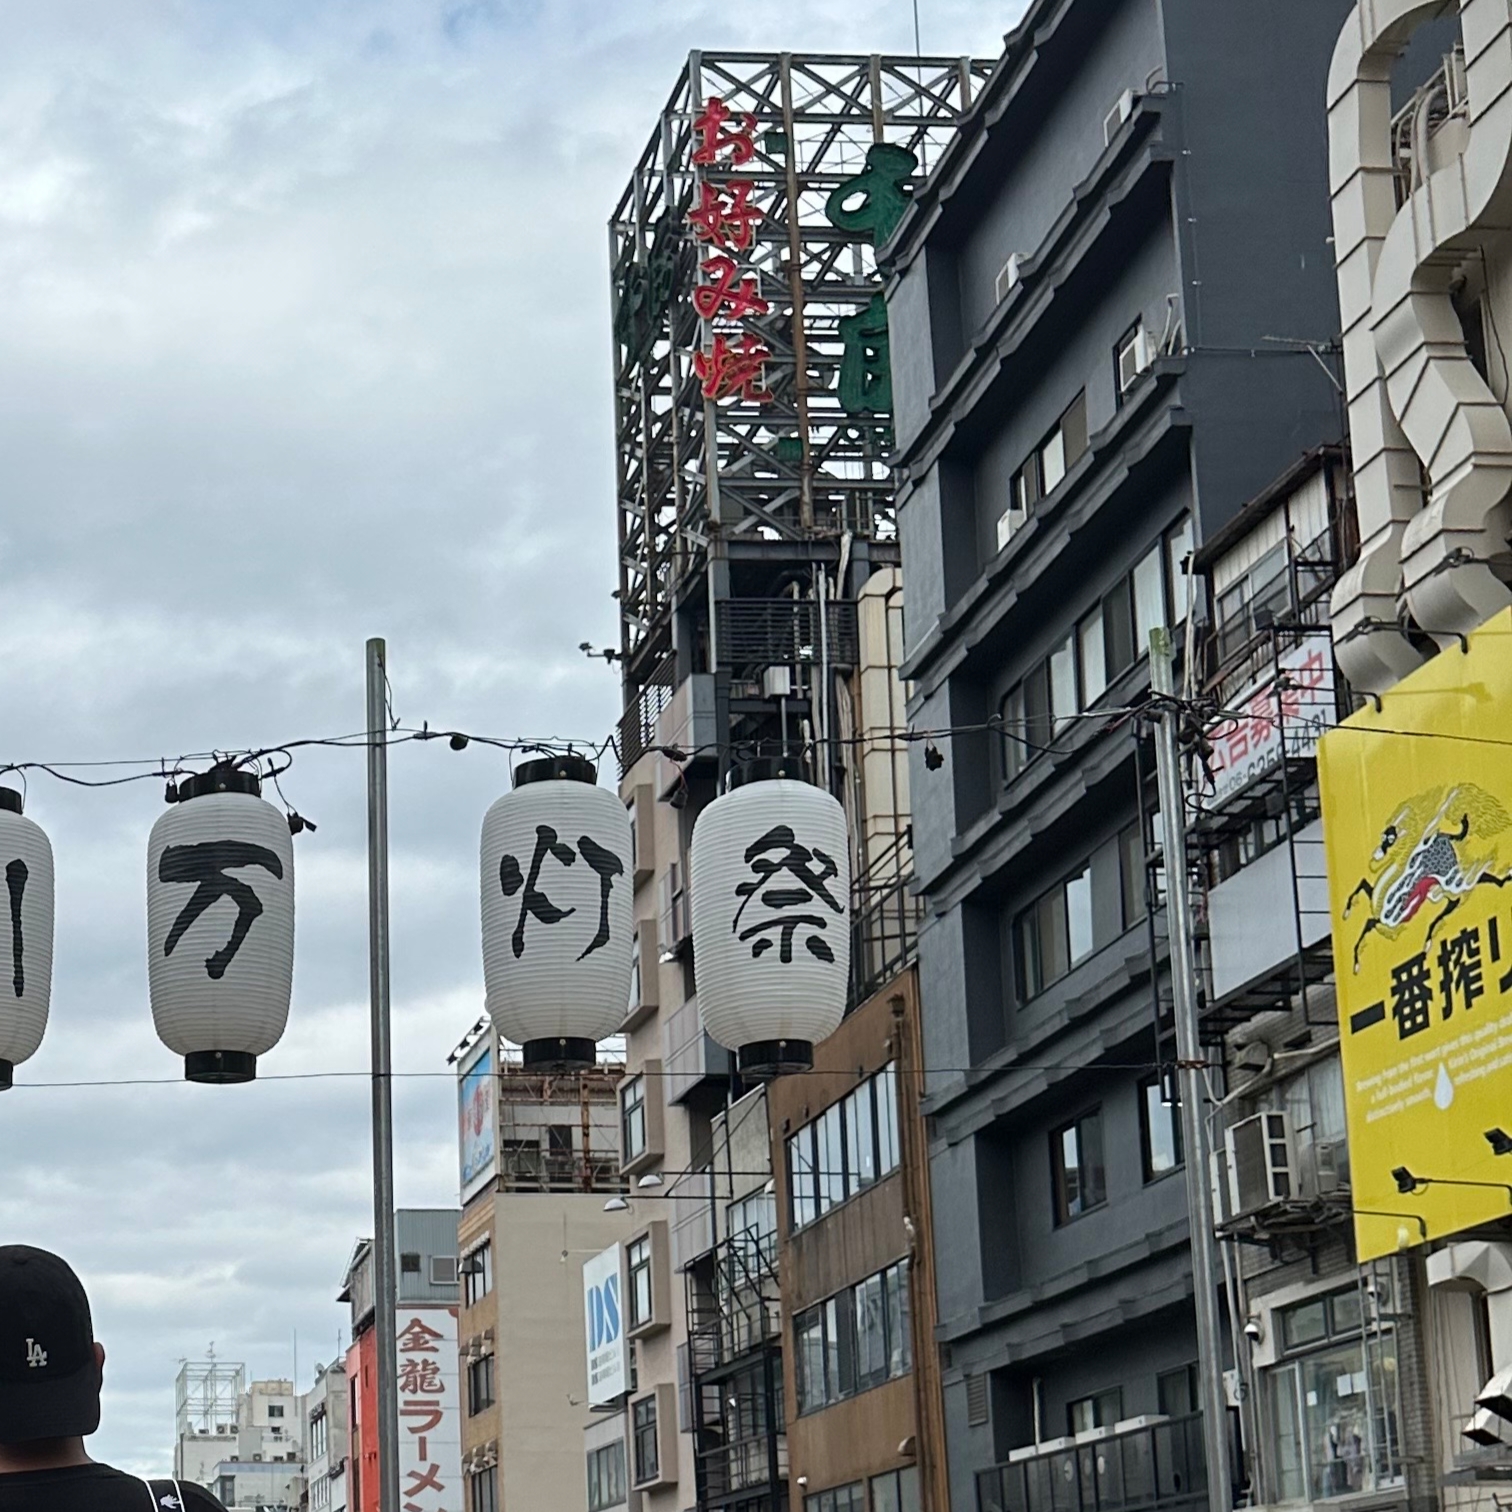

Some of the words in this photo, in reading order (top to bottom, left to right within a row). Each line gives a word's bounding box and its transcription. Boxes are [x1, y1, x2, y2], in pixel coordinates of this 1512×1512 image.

[159, 840, 282, 979] 万
[500, 825, 624, 961] 灯
[732, 825, 844, 963] 祭
[1350, 906, 1512, 1040] 一番搾り
[26, 1338, 47, 1367] LA
[587, 1272, 620, 1354] DS
